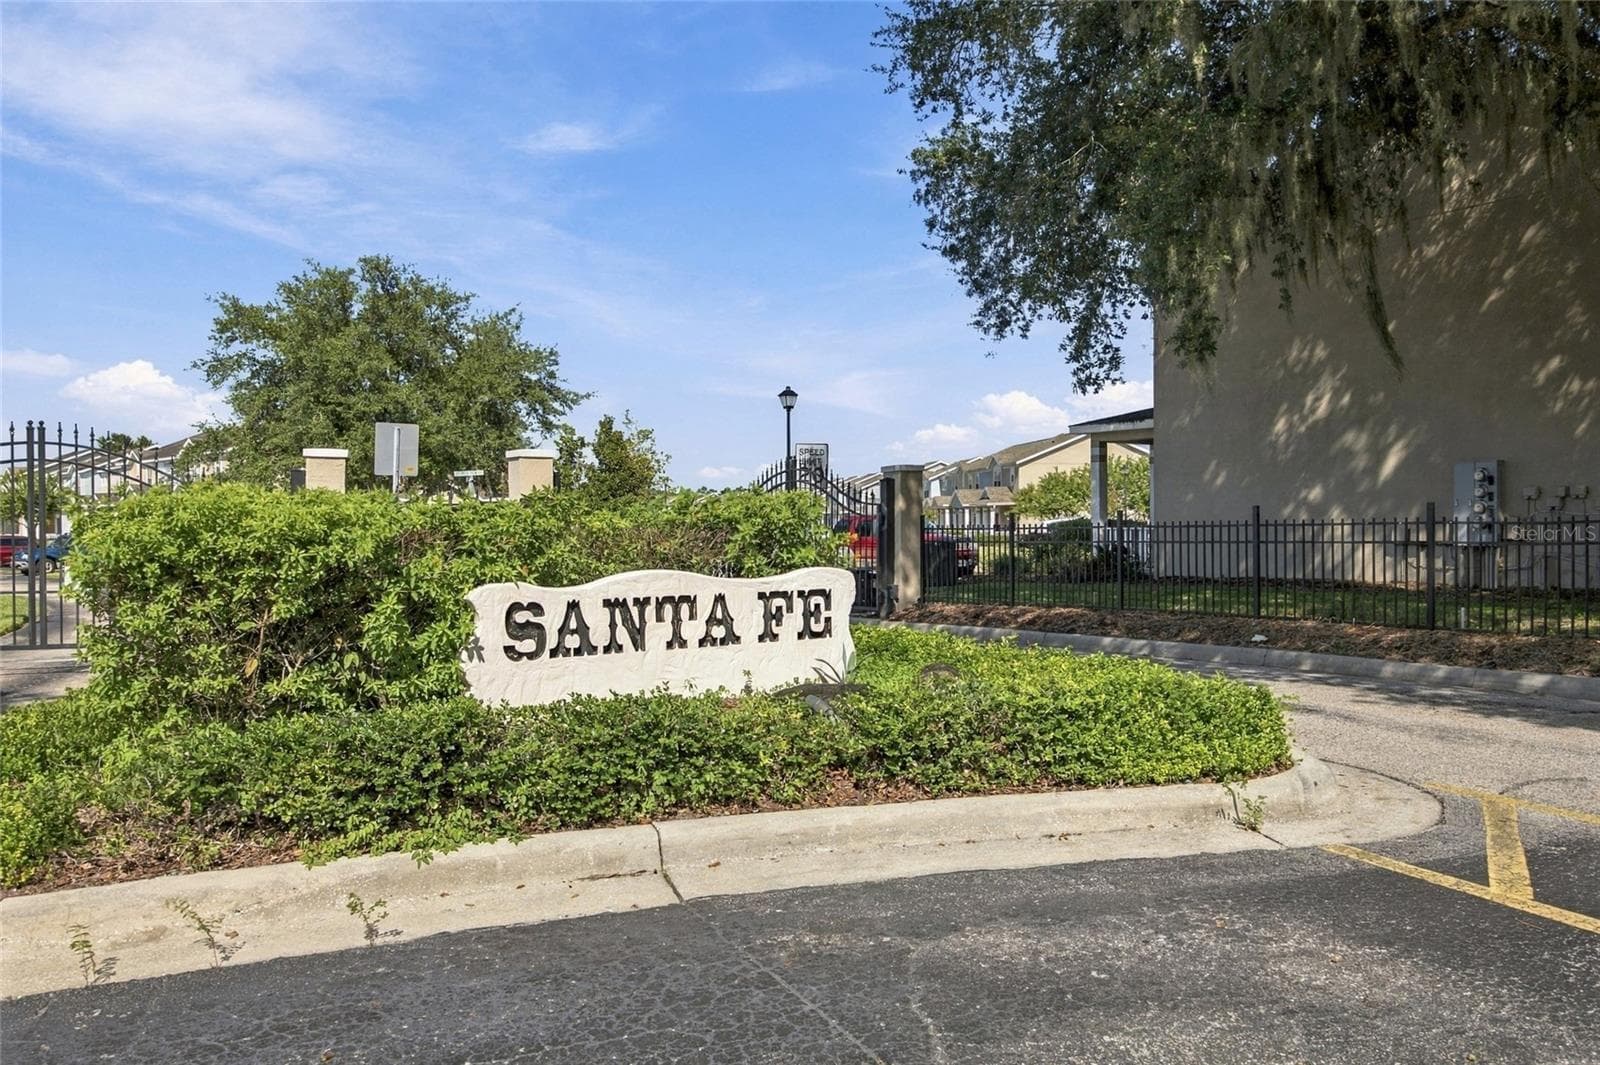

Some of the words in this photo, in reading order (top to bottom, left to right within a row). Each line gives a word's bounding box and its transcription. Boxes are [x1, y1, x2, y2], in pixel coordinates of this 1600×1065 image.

[799, 448, 825, 456] SPEED
[503, 592, 741, 662] SANTA
[758, 588, 833, 643] FE
